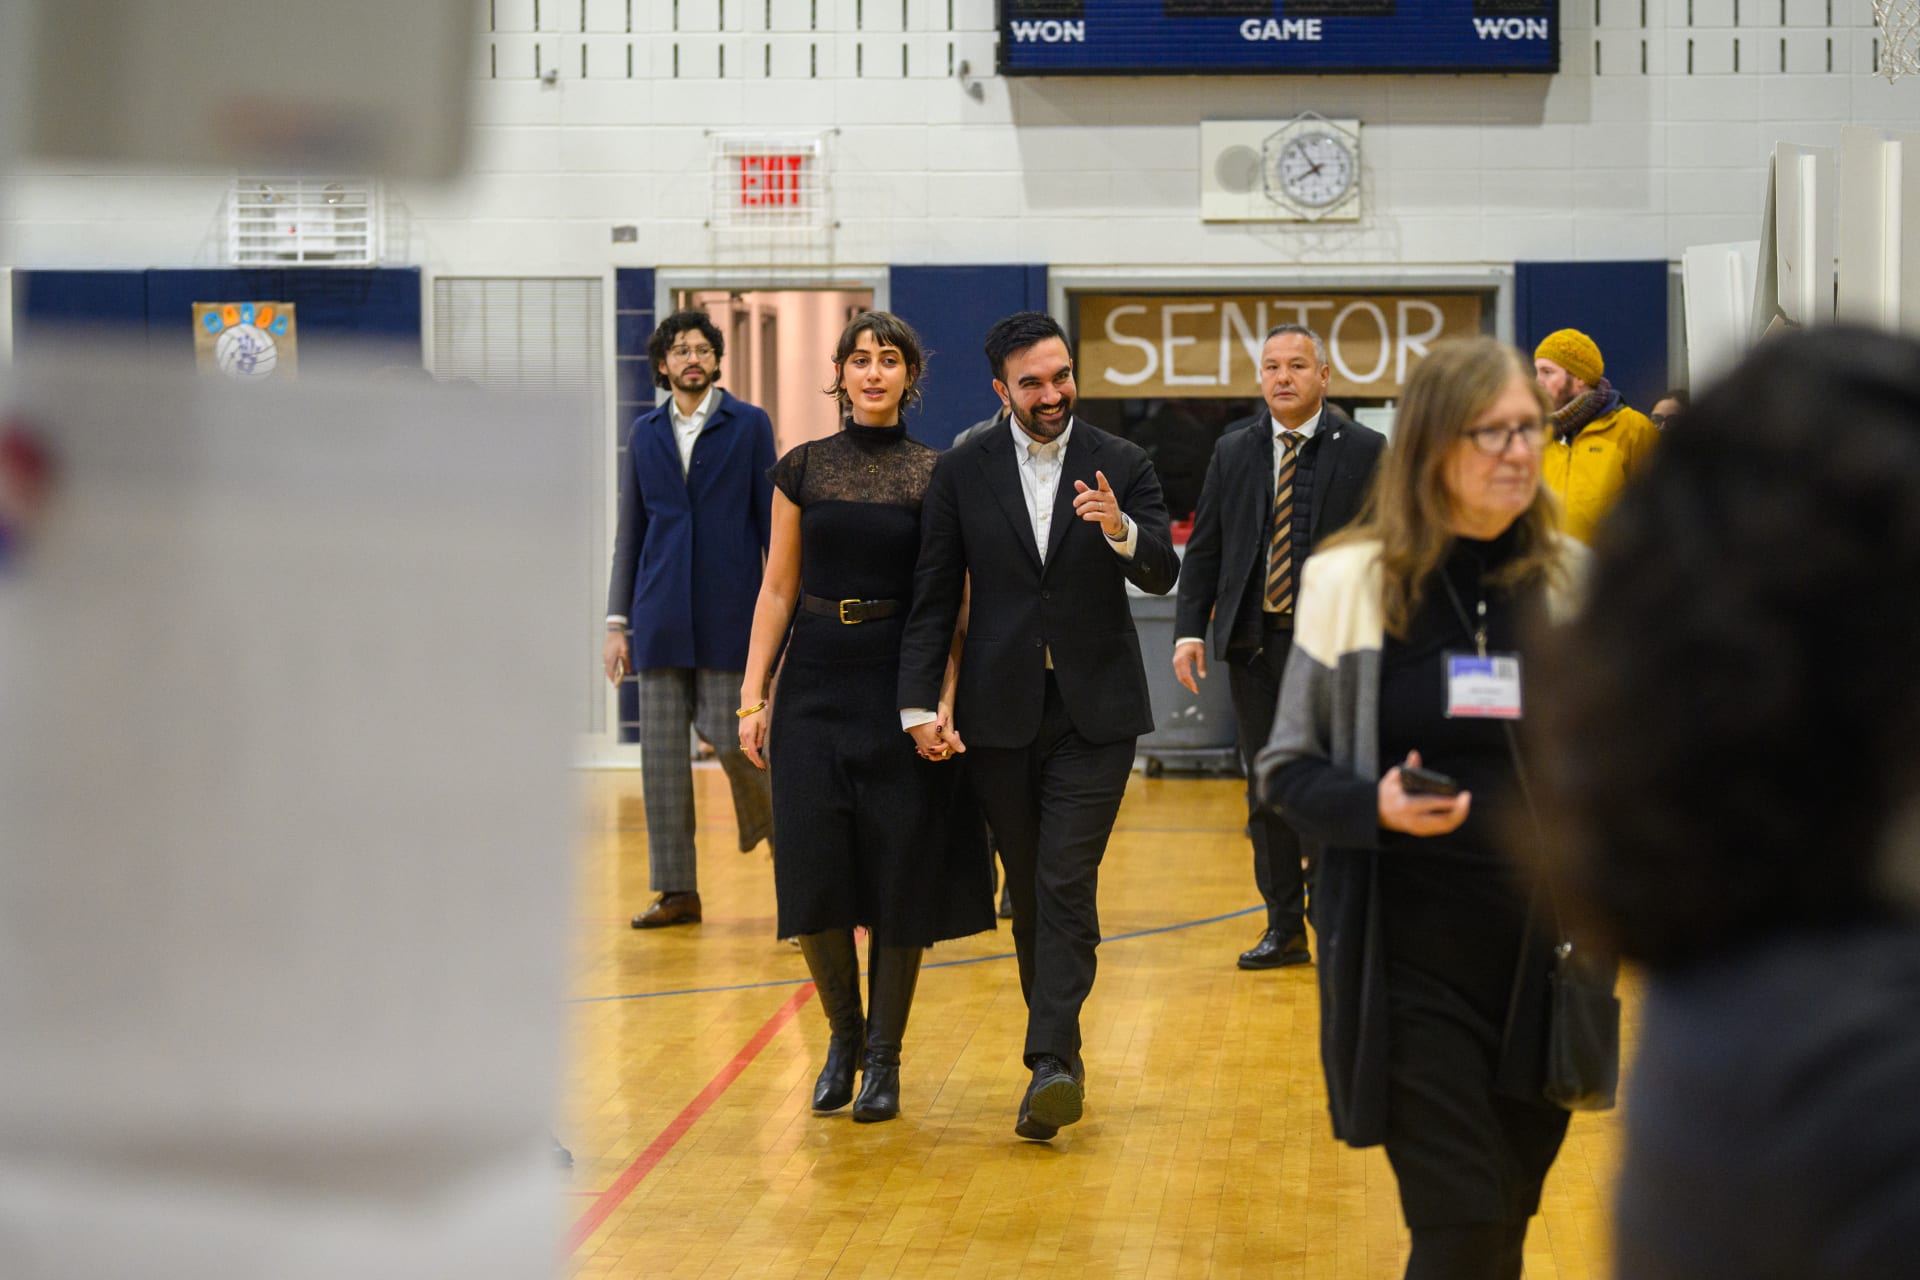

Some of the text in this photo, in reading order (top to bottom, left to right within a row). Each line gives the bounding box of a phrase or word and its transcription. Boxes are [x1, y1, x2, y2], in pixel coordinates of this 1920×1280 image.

[1010, 20, 1085, 42] WON
[1240, 19, 1322, 40] GAME
[1473, 18, 1547, 39] WON
[741, 155, 803, 204] EXIT
